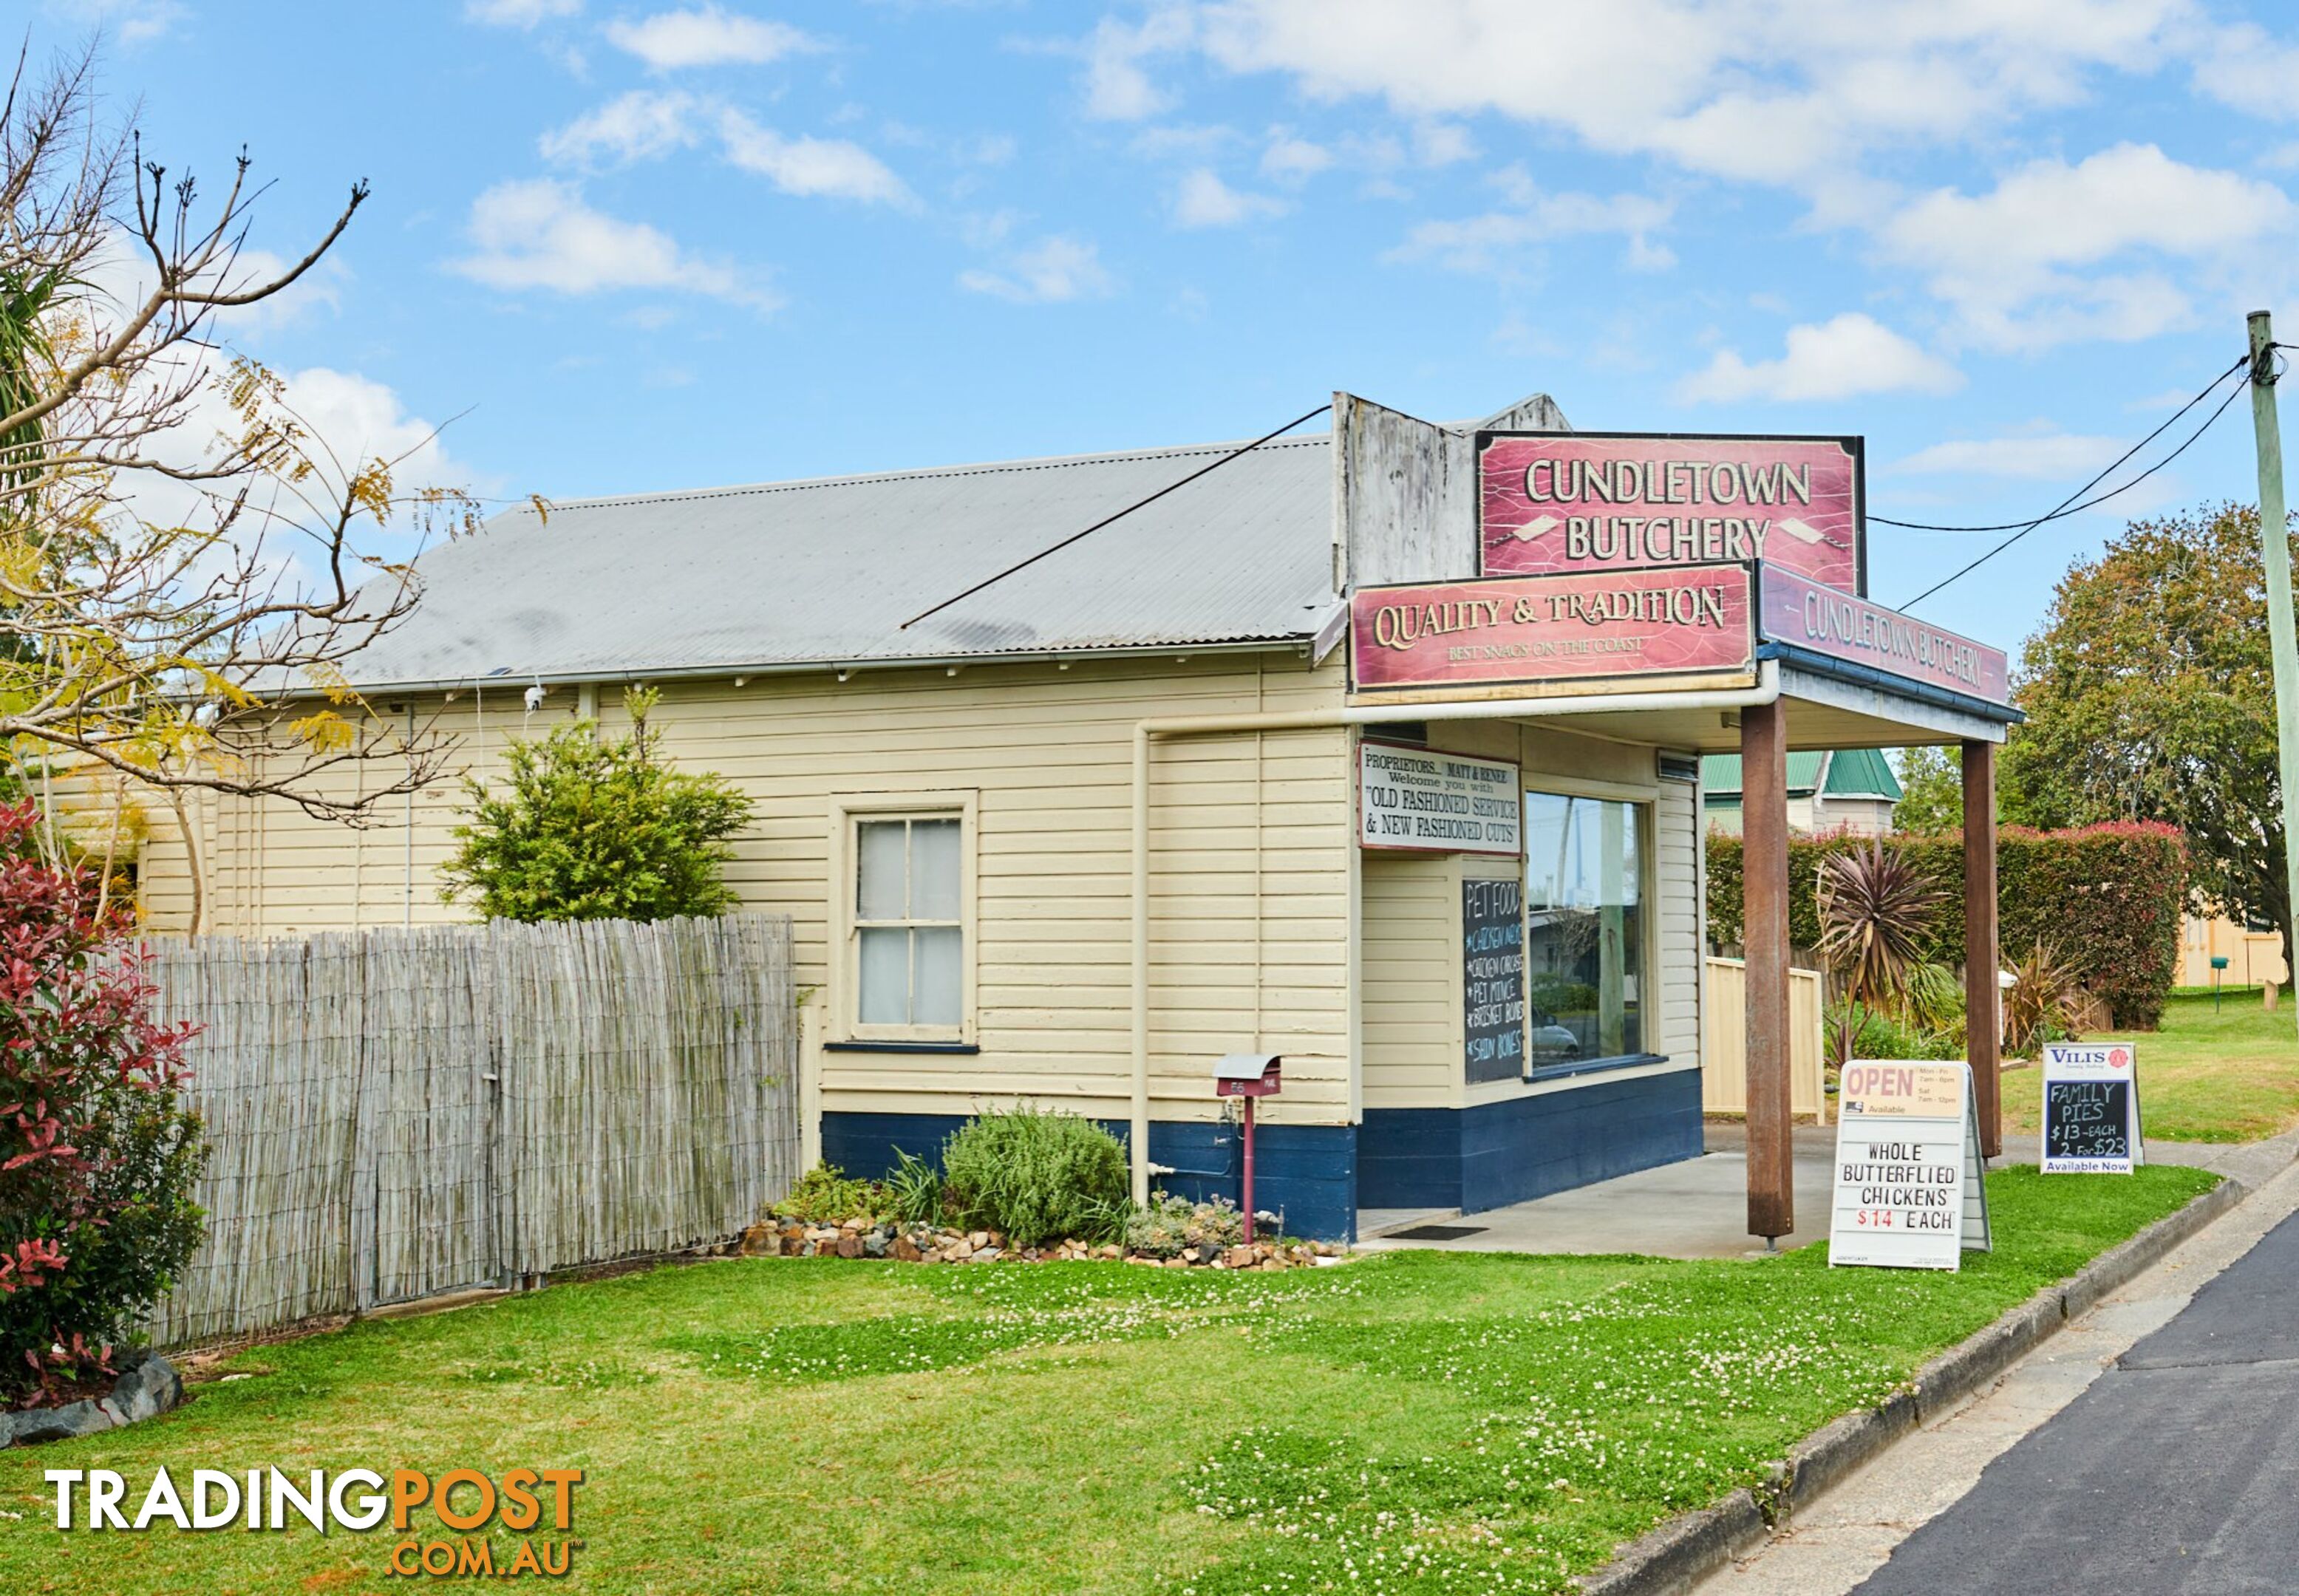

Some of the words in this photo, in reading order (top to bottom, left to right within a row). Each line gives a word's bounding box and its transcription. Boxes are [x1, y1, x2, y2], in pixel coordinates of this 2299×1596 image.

[1525, 459, 1811, 505] CUNDLETOWN
[1567, 516, 1771, 561] BUTCHERY
[1374, 598, 1504, 651] QUALITY
[1513, 596, 1536, 624] &
[1546, 584, 1726, 628] TRADITION
[1448, 646, 1478, 661] BEST
[1483, 644, 1528, 659] SNAGS
[1533, 641, 1555, 657] ON
[1562, 641, 1588, 655] THE
[1593, 637, 1644, 652] COAST
[1805, 590, 1915, 662] CUNDLETOWN
[1918, 630, 1982, 689] BUTCHERY
[1389, 771, 1440, 787] Welcome
[1445, 780, 1465, 791] you
[1471, 782, 1494, 794] with
[1403, 789, 1469, 815] FASHIONED
[1473, 797, 1517, 819] SERVICE
[1367, 813, 1377, 833] &
[1381, 814, 1411, 836] NEW
[1417, 817, 1482, 840] FASHIONED
[1467, 881, 1491, 918] PET
[1494, 882, 1520, 918] FOOD
[1474, 981, 1488, 1003] PET
[1847, 1068, 1914, 1097] OPEN
[2051, 1083, 2116, 1103] FAMILY
[1868, 1105, 1906, 1114] Available
[2063, 1102, 2105, 1122] PIES
[1869, 1142, 1922, 1161] WHOLE
[2060, 1142, 2072, 1157] 2
[1843, 1165, 1955, 1184] BUTTERFLIED
[2047, 1162, 2099, 1171] Available
[2102, 1162, 2128, 1171] Now
[1862, 1188, 1947, 1206] CHICKENS
[1858, 1210, 1893, 1227] $14
[1907, 1212, 1952, 1229] EACH
